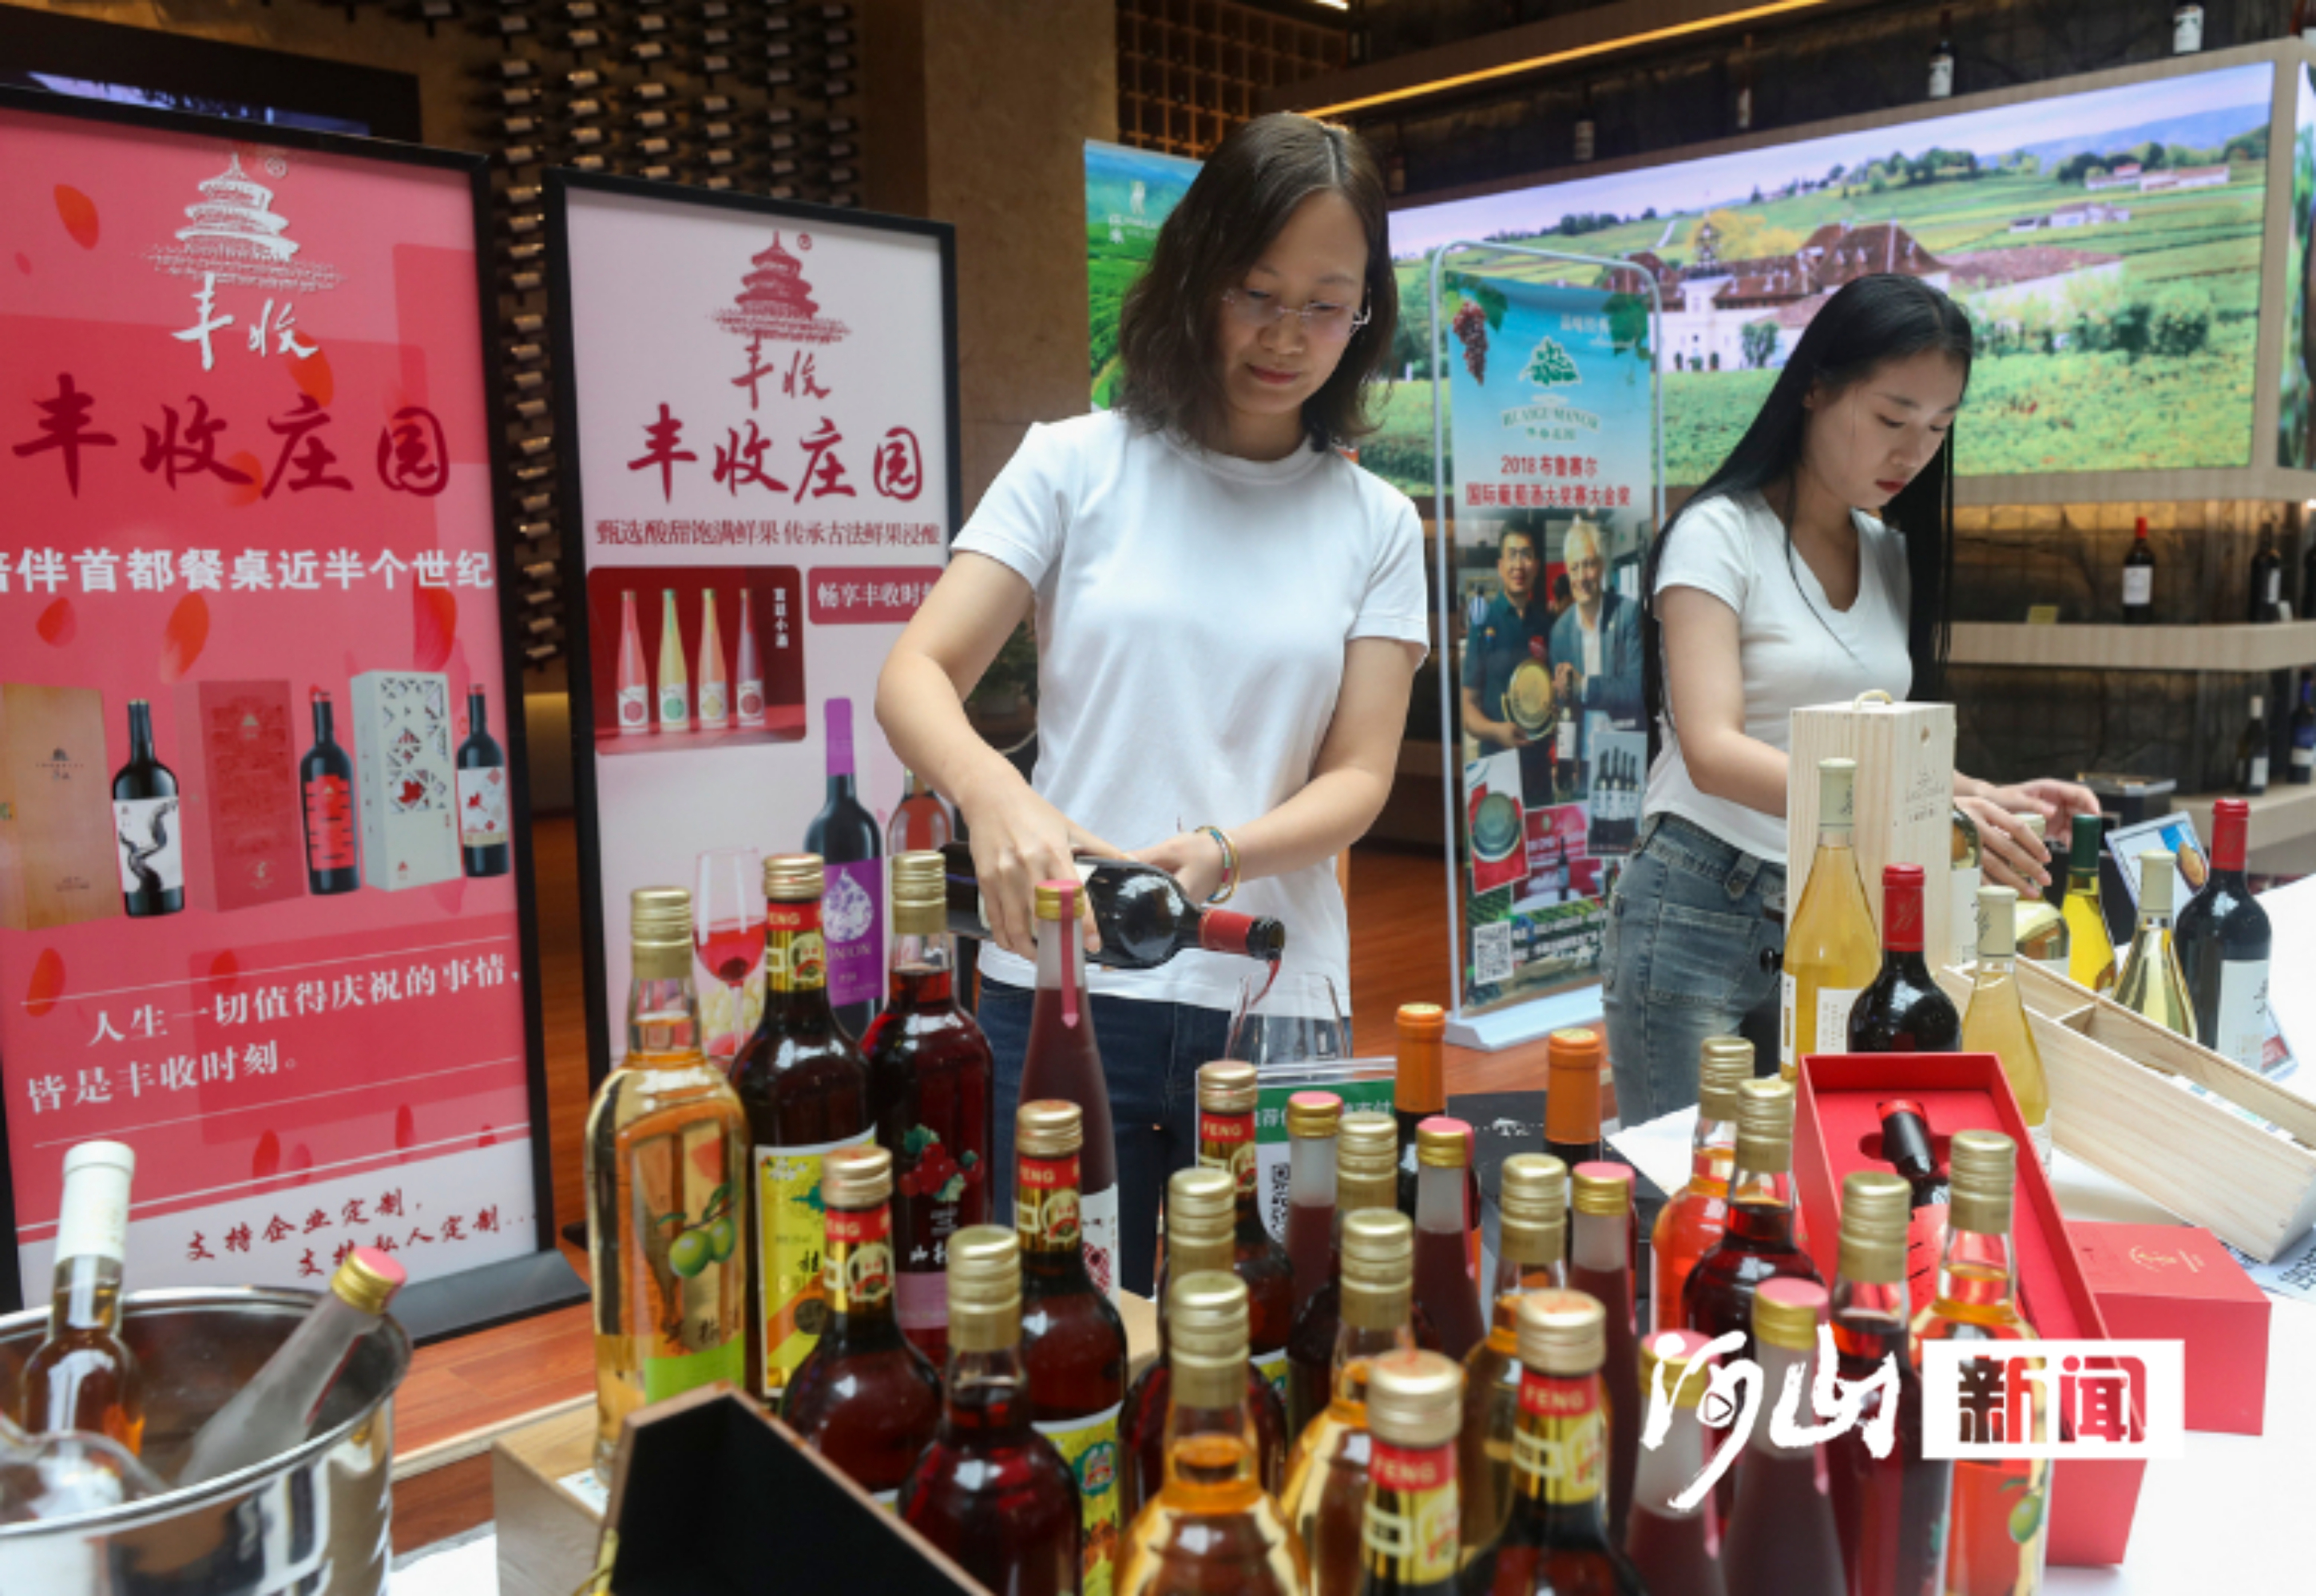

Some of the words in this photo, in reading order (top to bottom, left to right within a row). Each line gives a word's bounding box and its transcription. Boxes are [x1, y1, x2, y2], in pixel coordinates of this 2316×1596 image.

[171, 272, 319, 372] 丰收
[730, 329, 832, 411] 丰收
[11, 372, 450, 500] 丰收庄园
[626, 402, 924, 505] 丰收庄园
